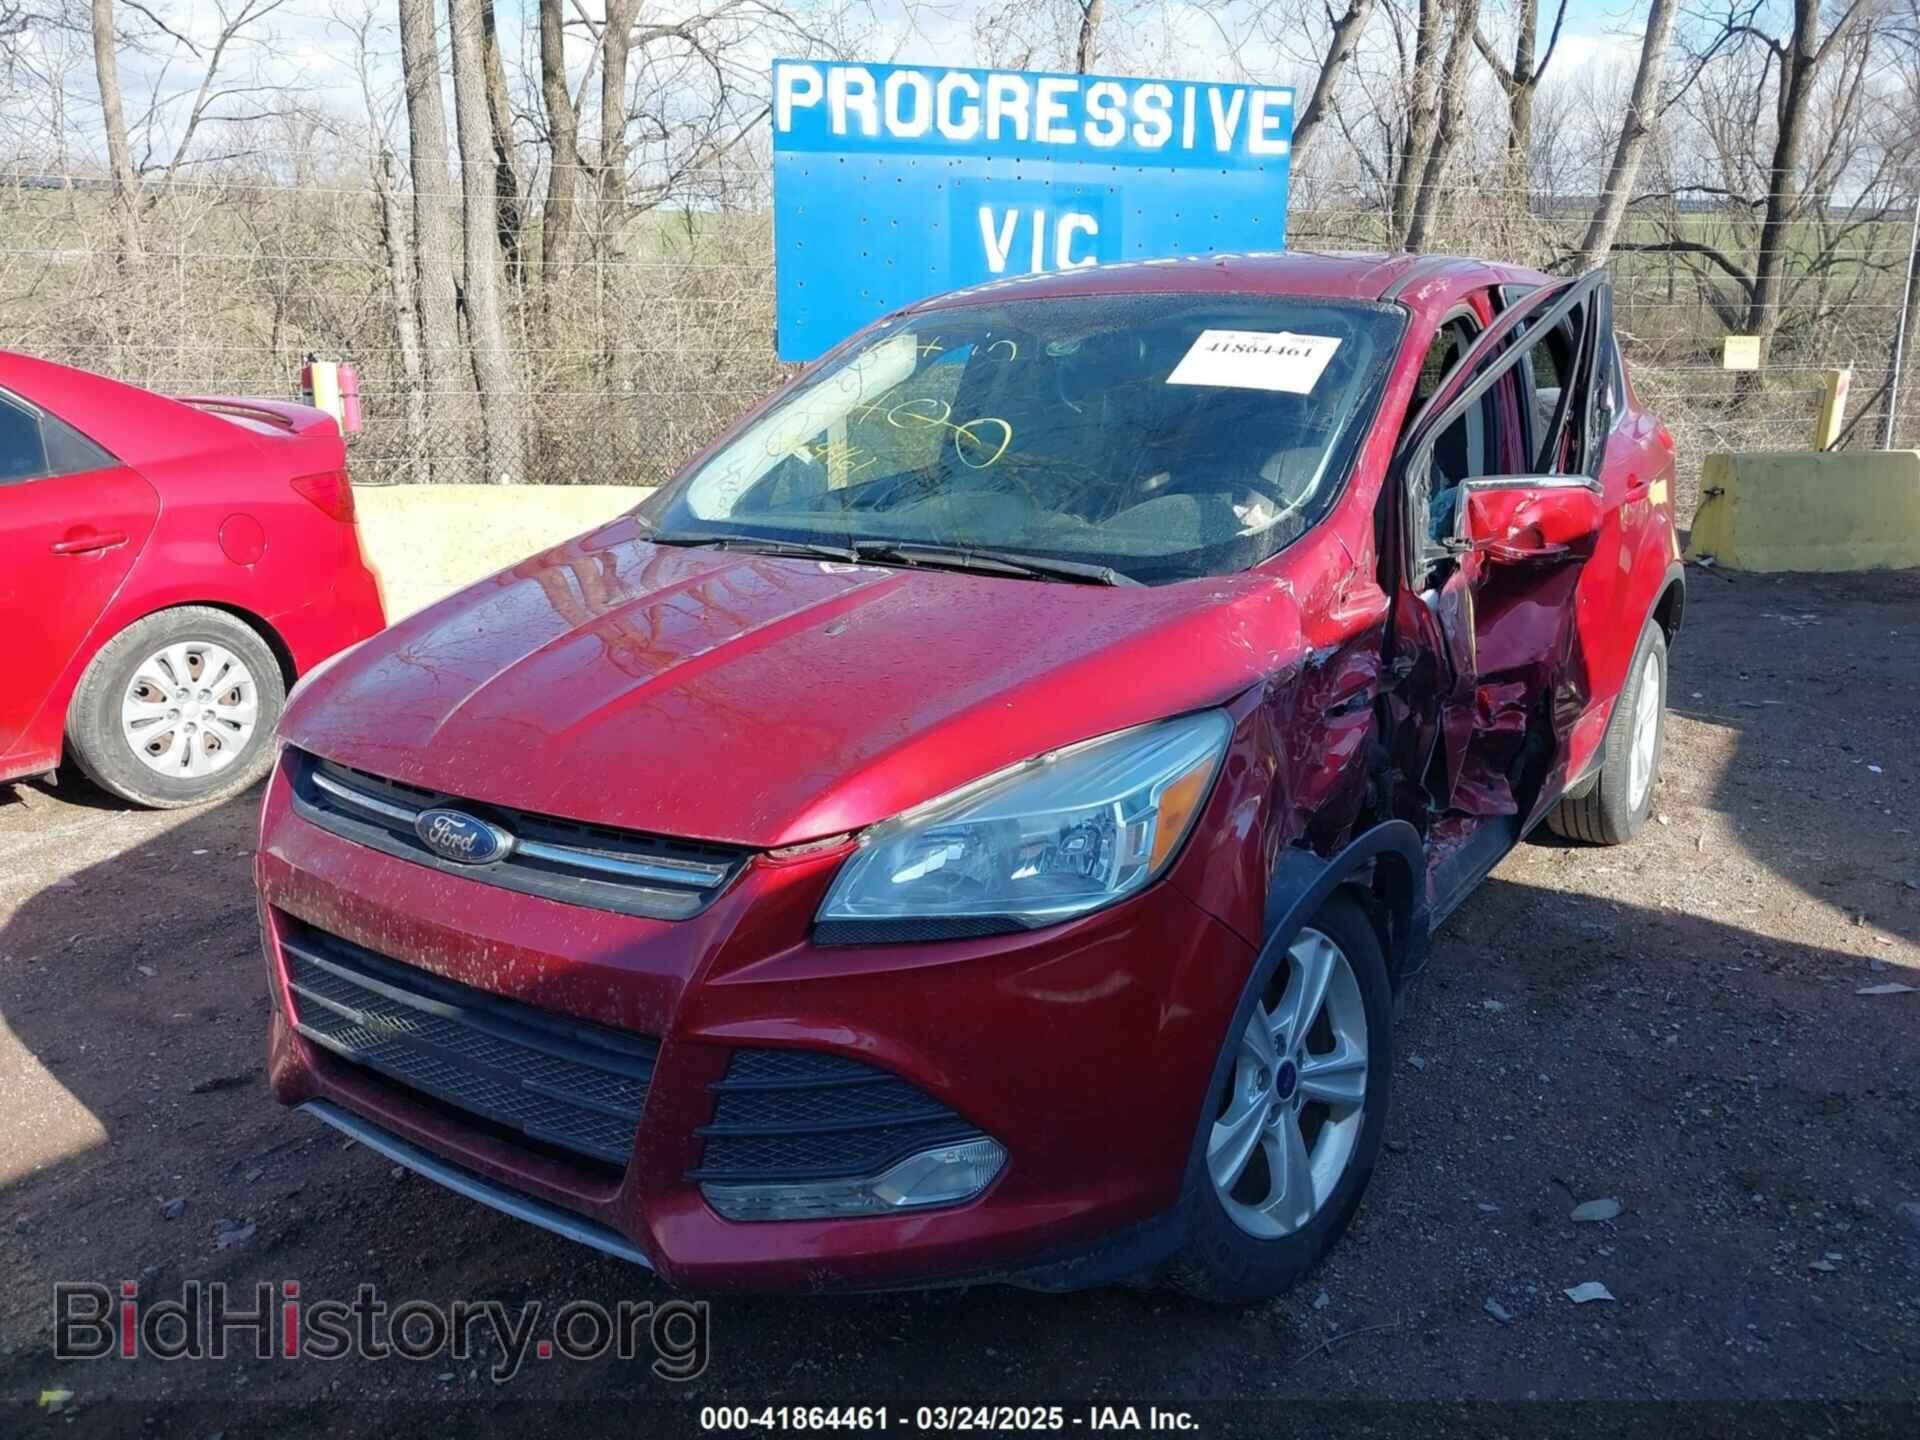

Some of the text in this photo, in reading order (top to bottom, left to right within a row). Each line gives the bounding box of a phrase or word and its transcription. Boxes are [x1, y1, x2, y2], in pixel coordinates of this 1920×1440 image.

[777, 62, 1293, 155] PROGRESSIVE
[978, 205, 1100, 274] VIC
[1206, 341, 1313, 358] 41864461
[428, 815, 478, 852] Ford
